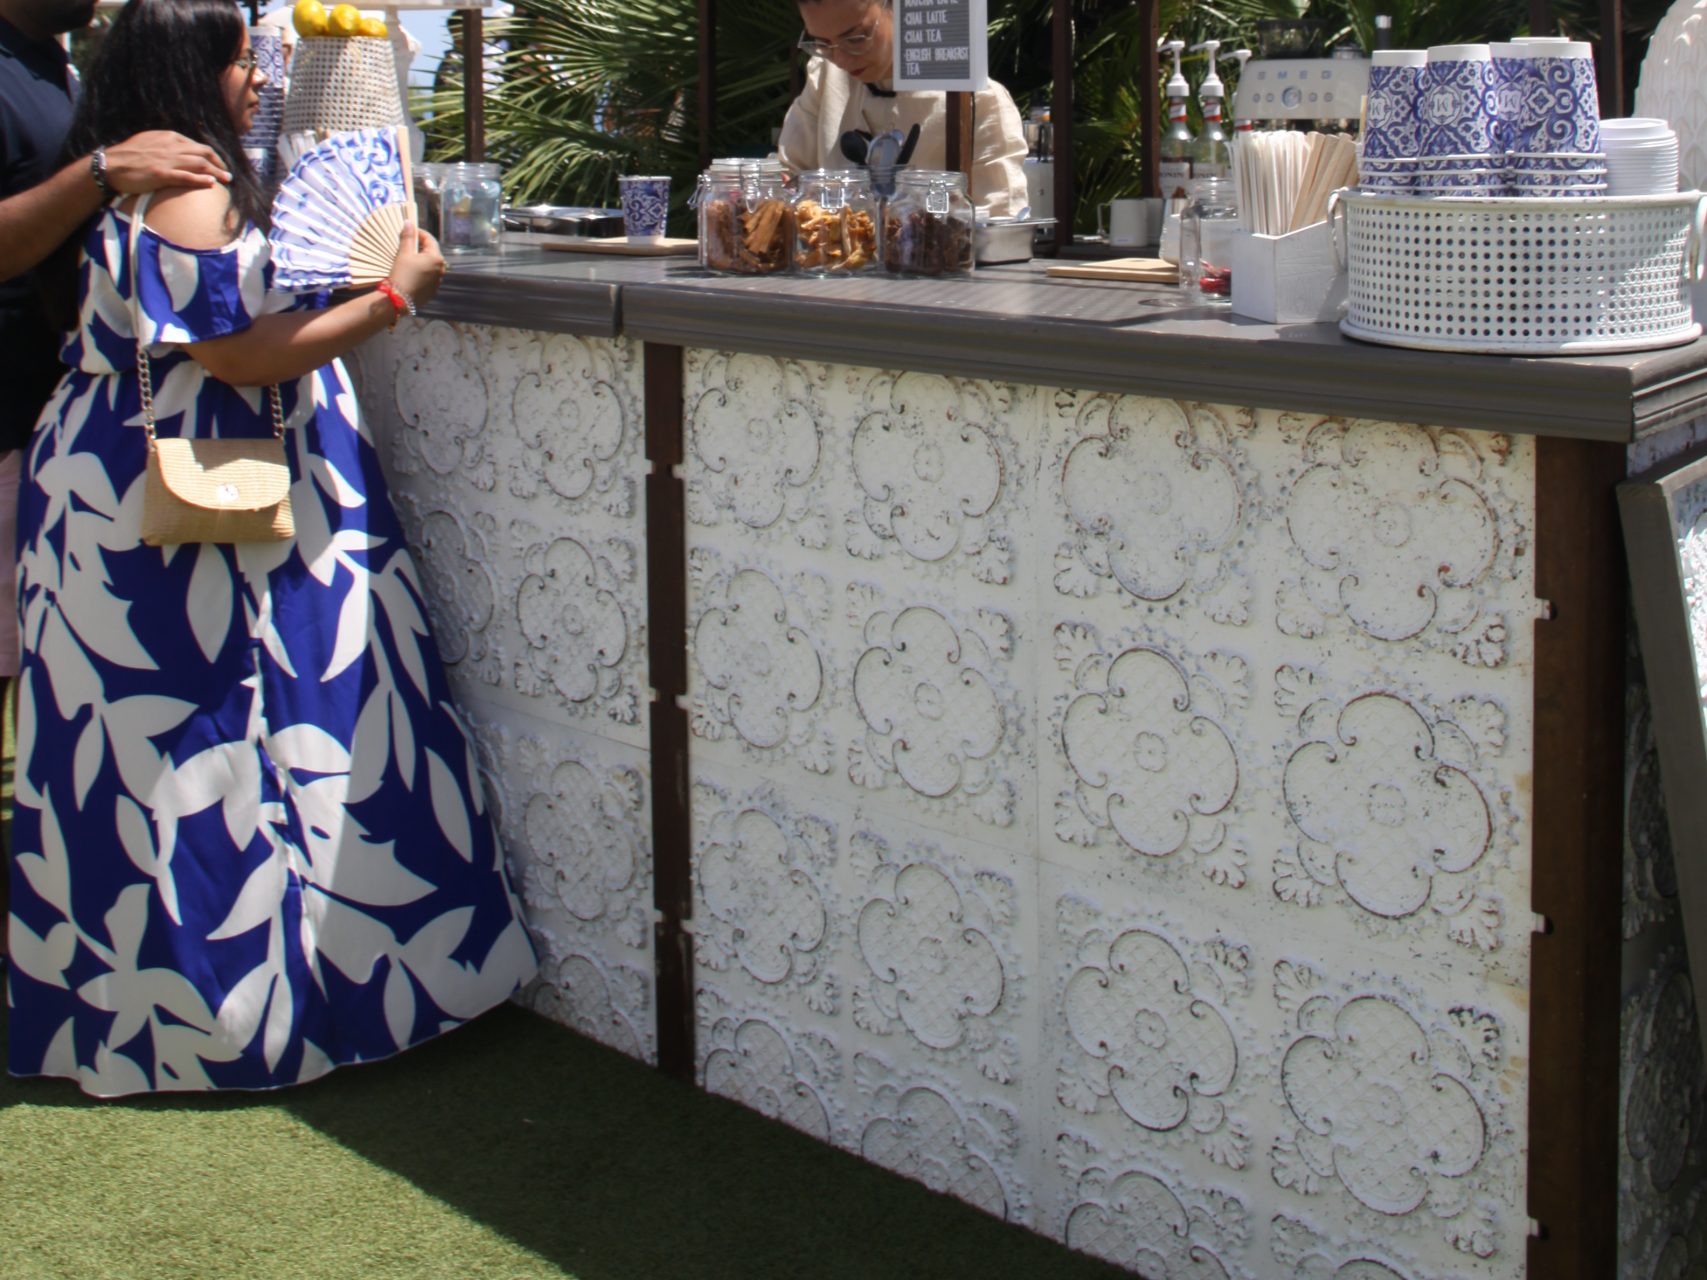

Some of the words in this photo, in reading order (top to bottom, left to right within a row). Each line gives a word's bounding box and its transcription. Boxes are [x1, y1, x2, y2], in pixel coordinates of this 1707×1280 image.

[906, 12, 923, 25] CHAI
[927, 11, 948, 24] LATTE
[906, 30, 923, 44] CHAI
[926, 29, 942, 43] TEA
[906, 49, 932, 62] ENGLISH
[907, 63, 920, 76] TEA
[1257, 70, 1332, 81] SMEG
